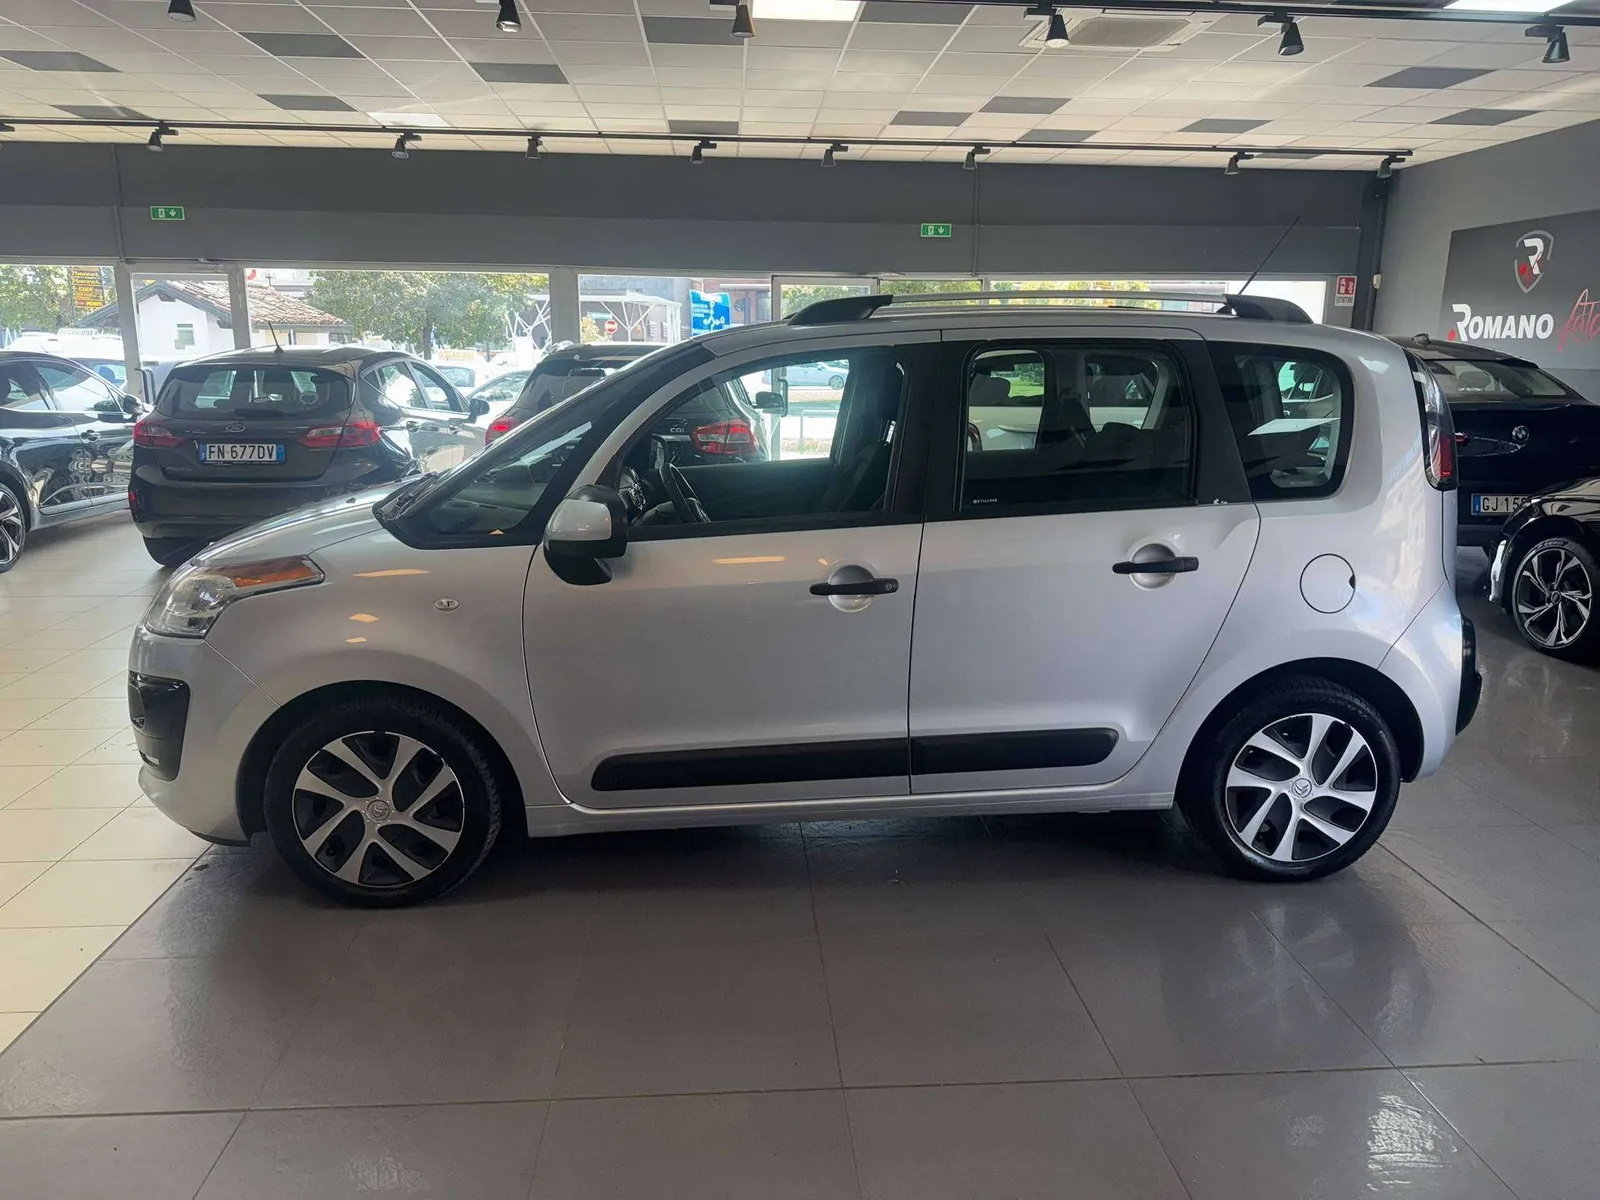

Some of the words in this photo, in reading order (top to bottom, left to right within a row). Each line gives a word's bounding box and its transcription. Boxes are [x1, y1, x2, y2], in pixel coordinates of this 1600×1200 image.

[1450, 303, 1554, 341] ROMANO
[208, 445, 225, 460] FN
[230, 445, 275, 460] 677DV
[1482, 496, 1499, 512] GJ
